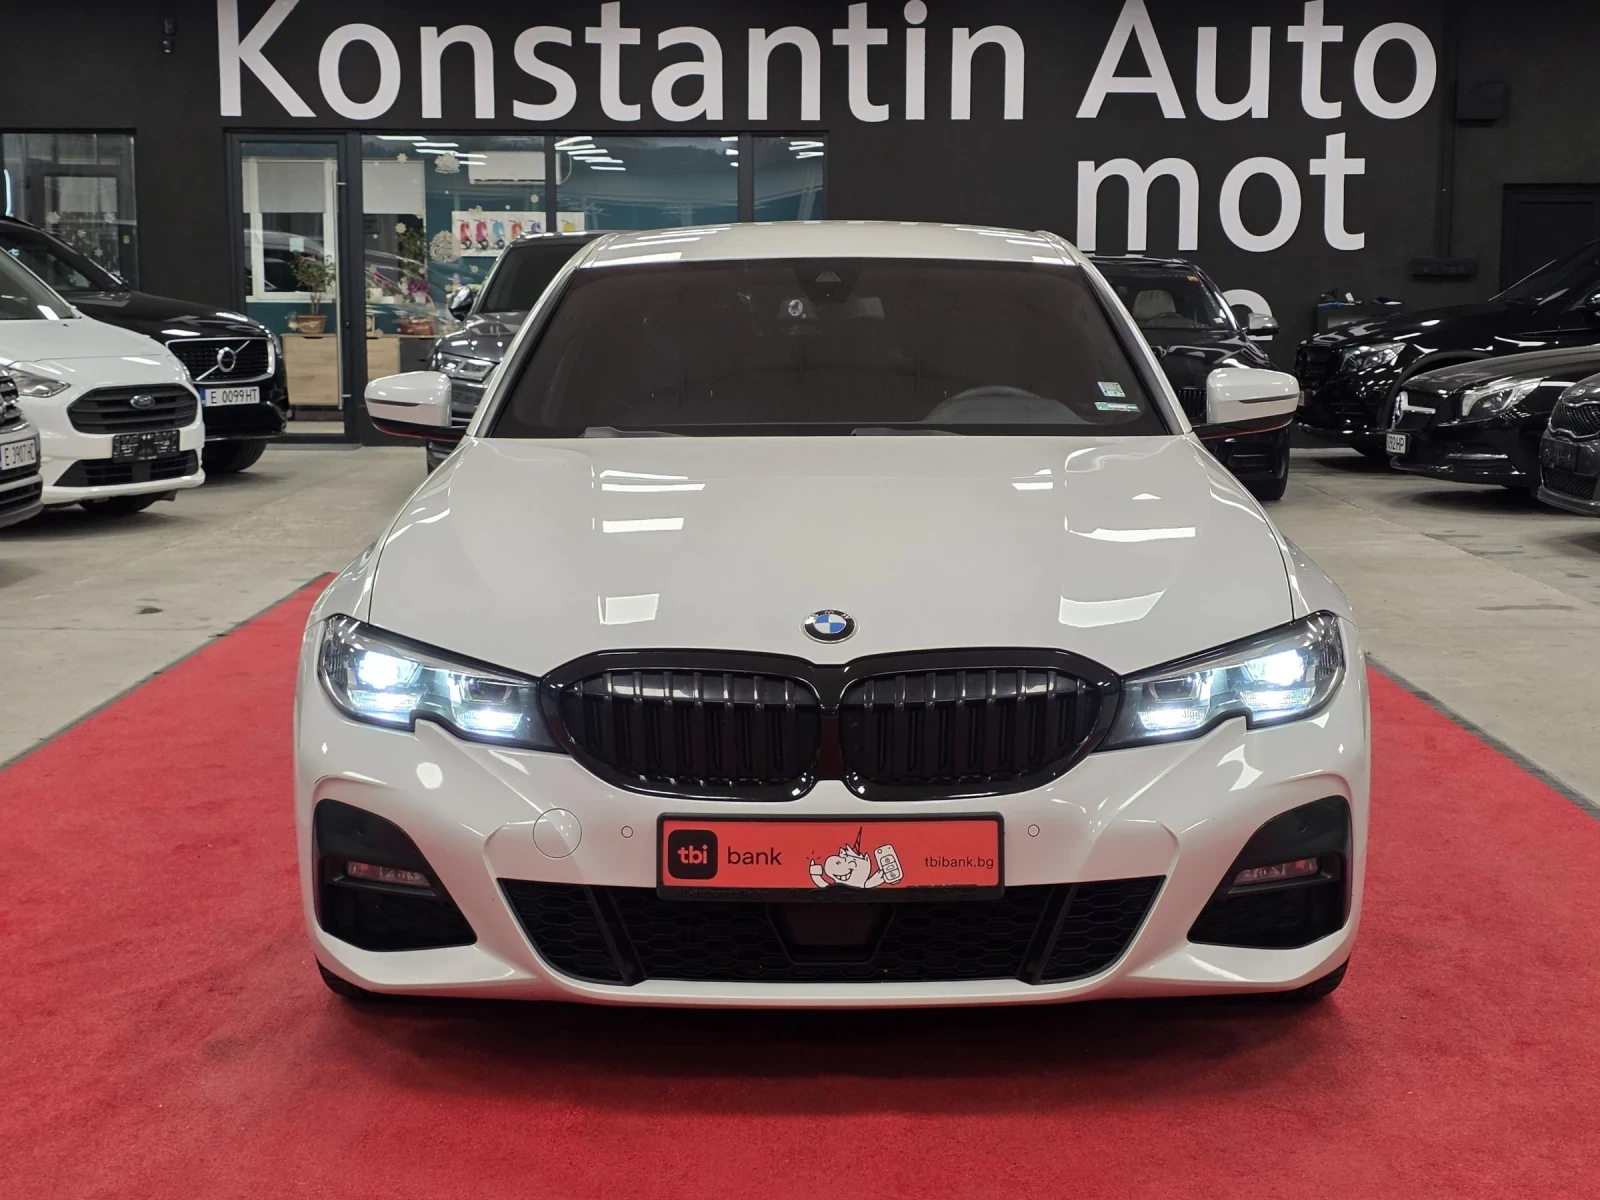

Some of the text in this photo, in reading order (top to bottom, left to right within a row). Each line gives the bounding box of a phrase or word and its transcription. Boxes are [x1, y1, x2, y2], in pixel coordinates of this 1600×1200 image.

[217, 0, 1437, 122] Konstantin Auto
[1077, 132, 1366, 253] mot
[210, 391, 218, 404] E
[677, 844, 782, 865] tbi bank
[924, 856, 994, 869] tbibank.bg
